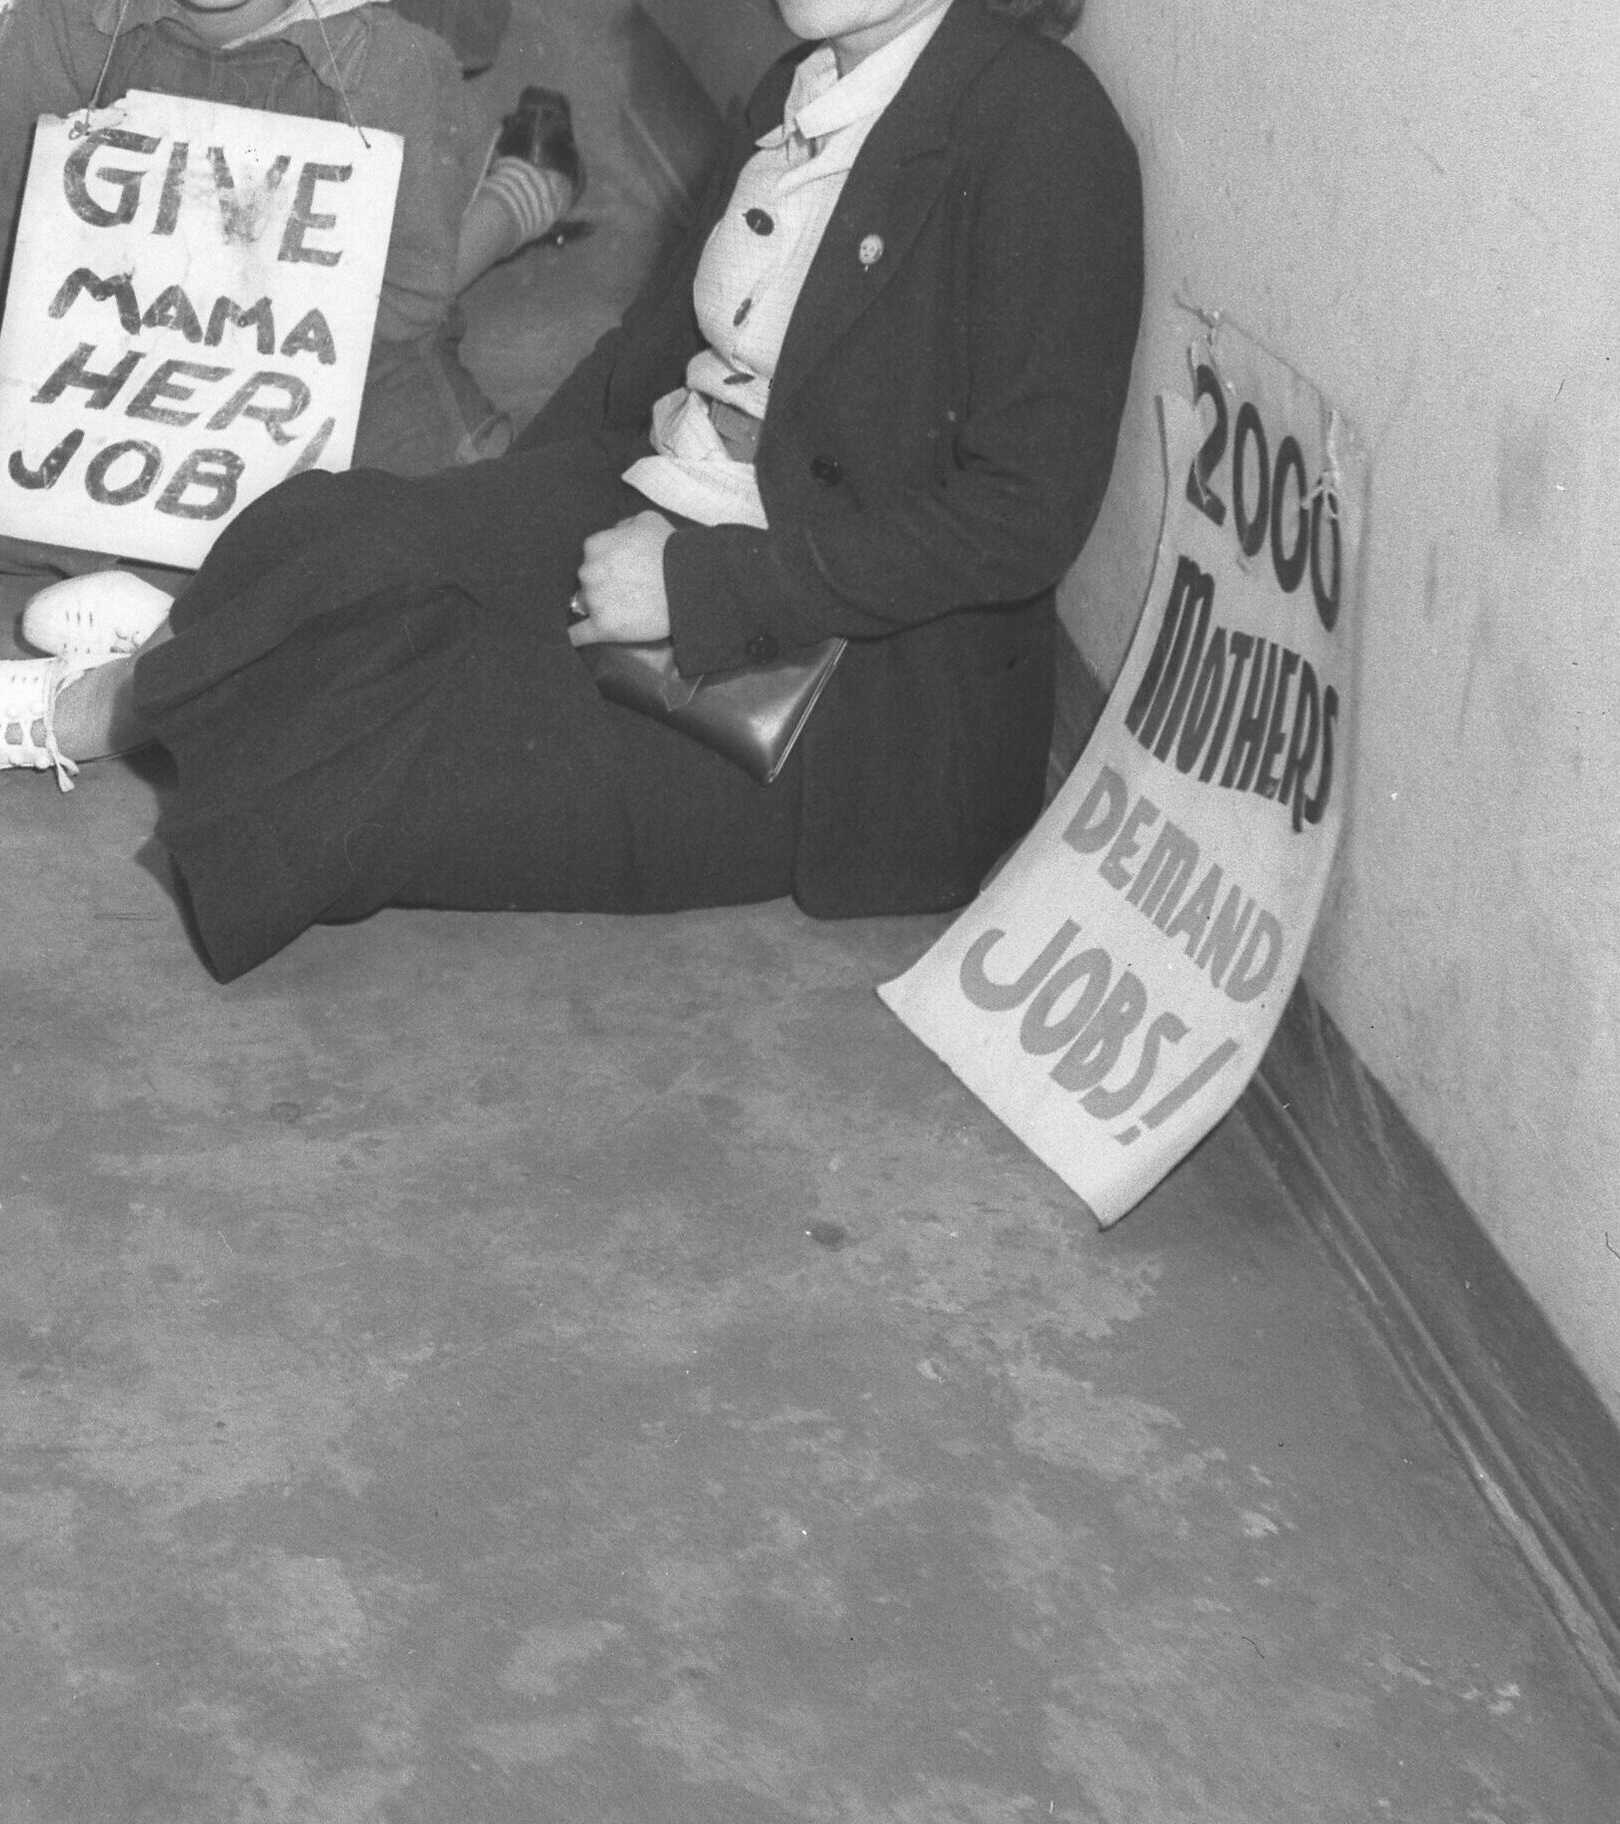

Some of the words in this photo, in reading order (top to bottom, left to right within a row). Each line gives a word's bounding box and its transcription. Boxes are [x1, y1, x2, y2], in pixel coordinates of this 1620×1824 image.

[62, 127, 354, 267] GIVE
[29, 342, 312, 446] HER
[47, 266, 337, 366] MAMA
[1185, 363, 1343, 632] 2000
[1125, 555, 1340, 834] MOTHERS
[1060, 765, 1285, 1005] DEMAND
[958, 917, 1243, 1147] JOBS!
